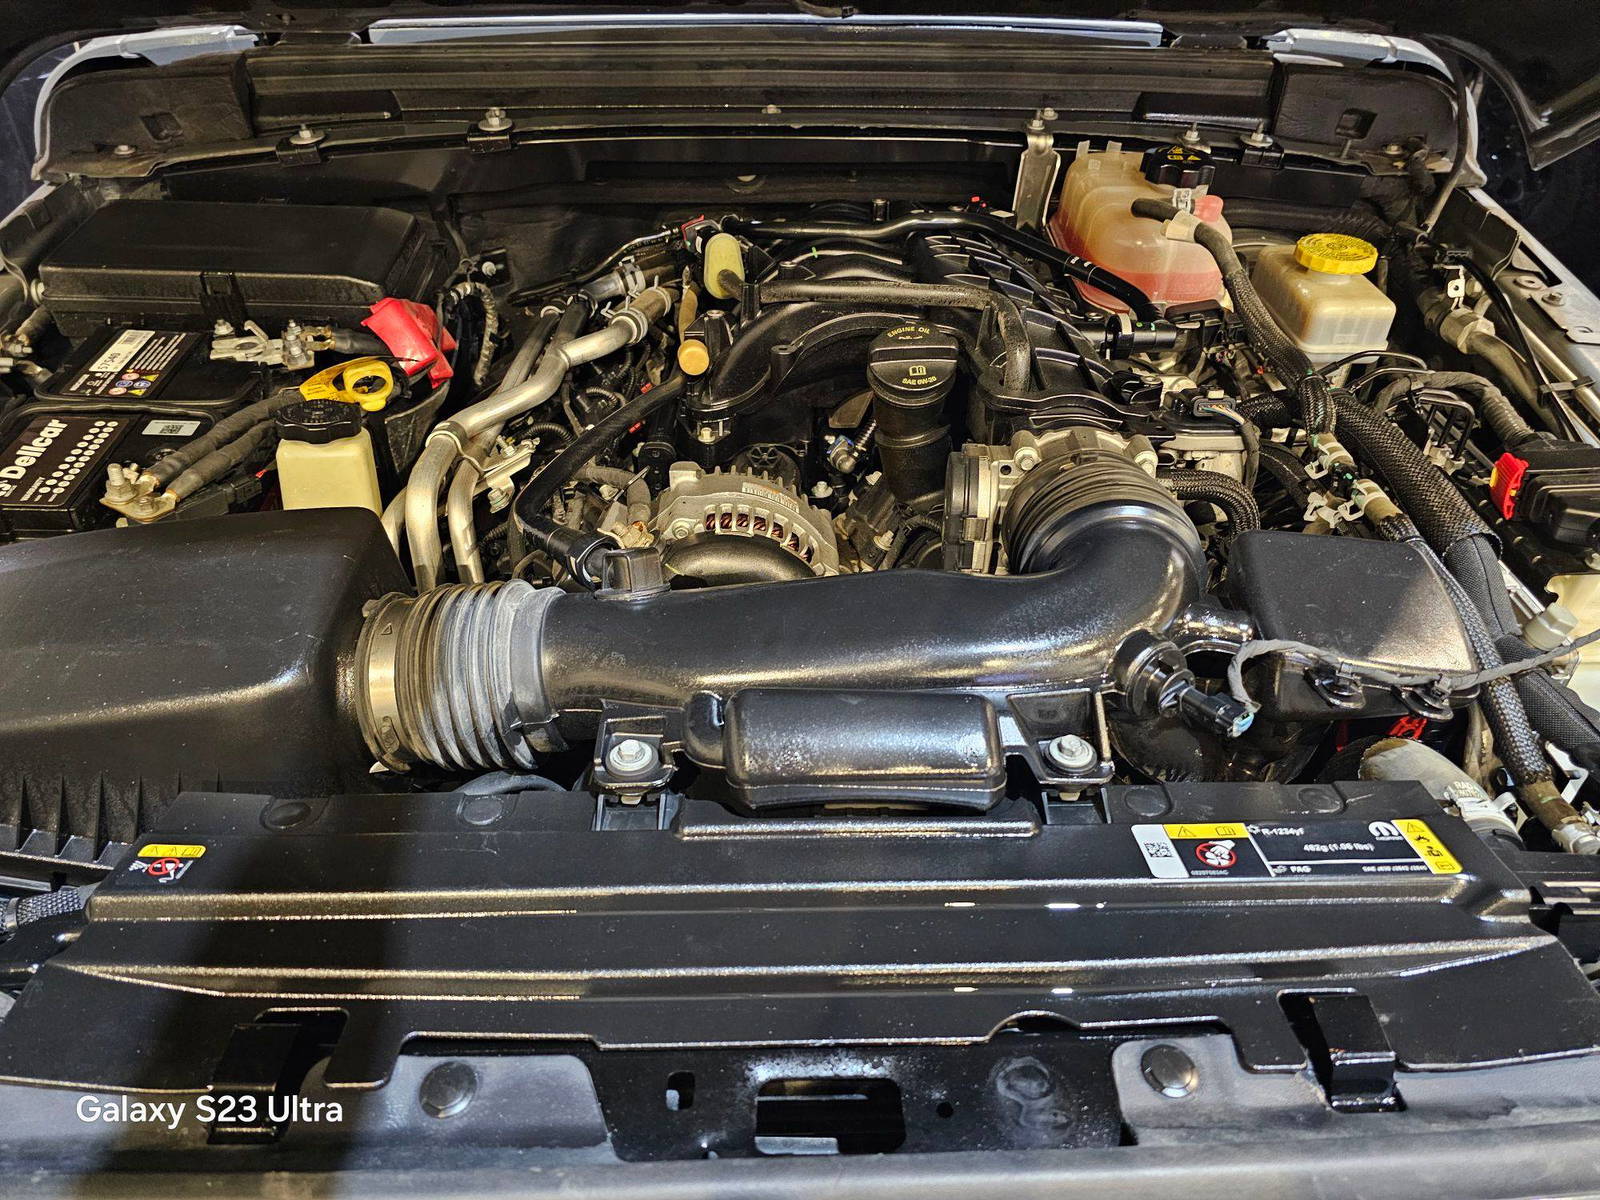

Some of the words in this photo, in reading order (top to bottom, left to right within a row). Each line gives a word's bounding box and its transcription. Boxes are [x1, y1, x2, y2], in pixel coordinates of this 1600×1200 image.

[887, 326, 915, 337] ENGINE
[918, 326, 930, 334] OIL
[0, 419, 68, 480] Dellcar
[1290, 865, 1312, 874] PAG
